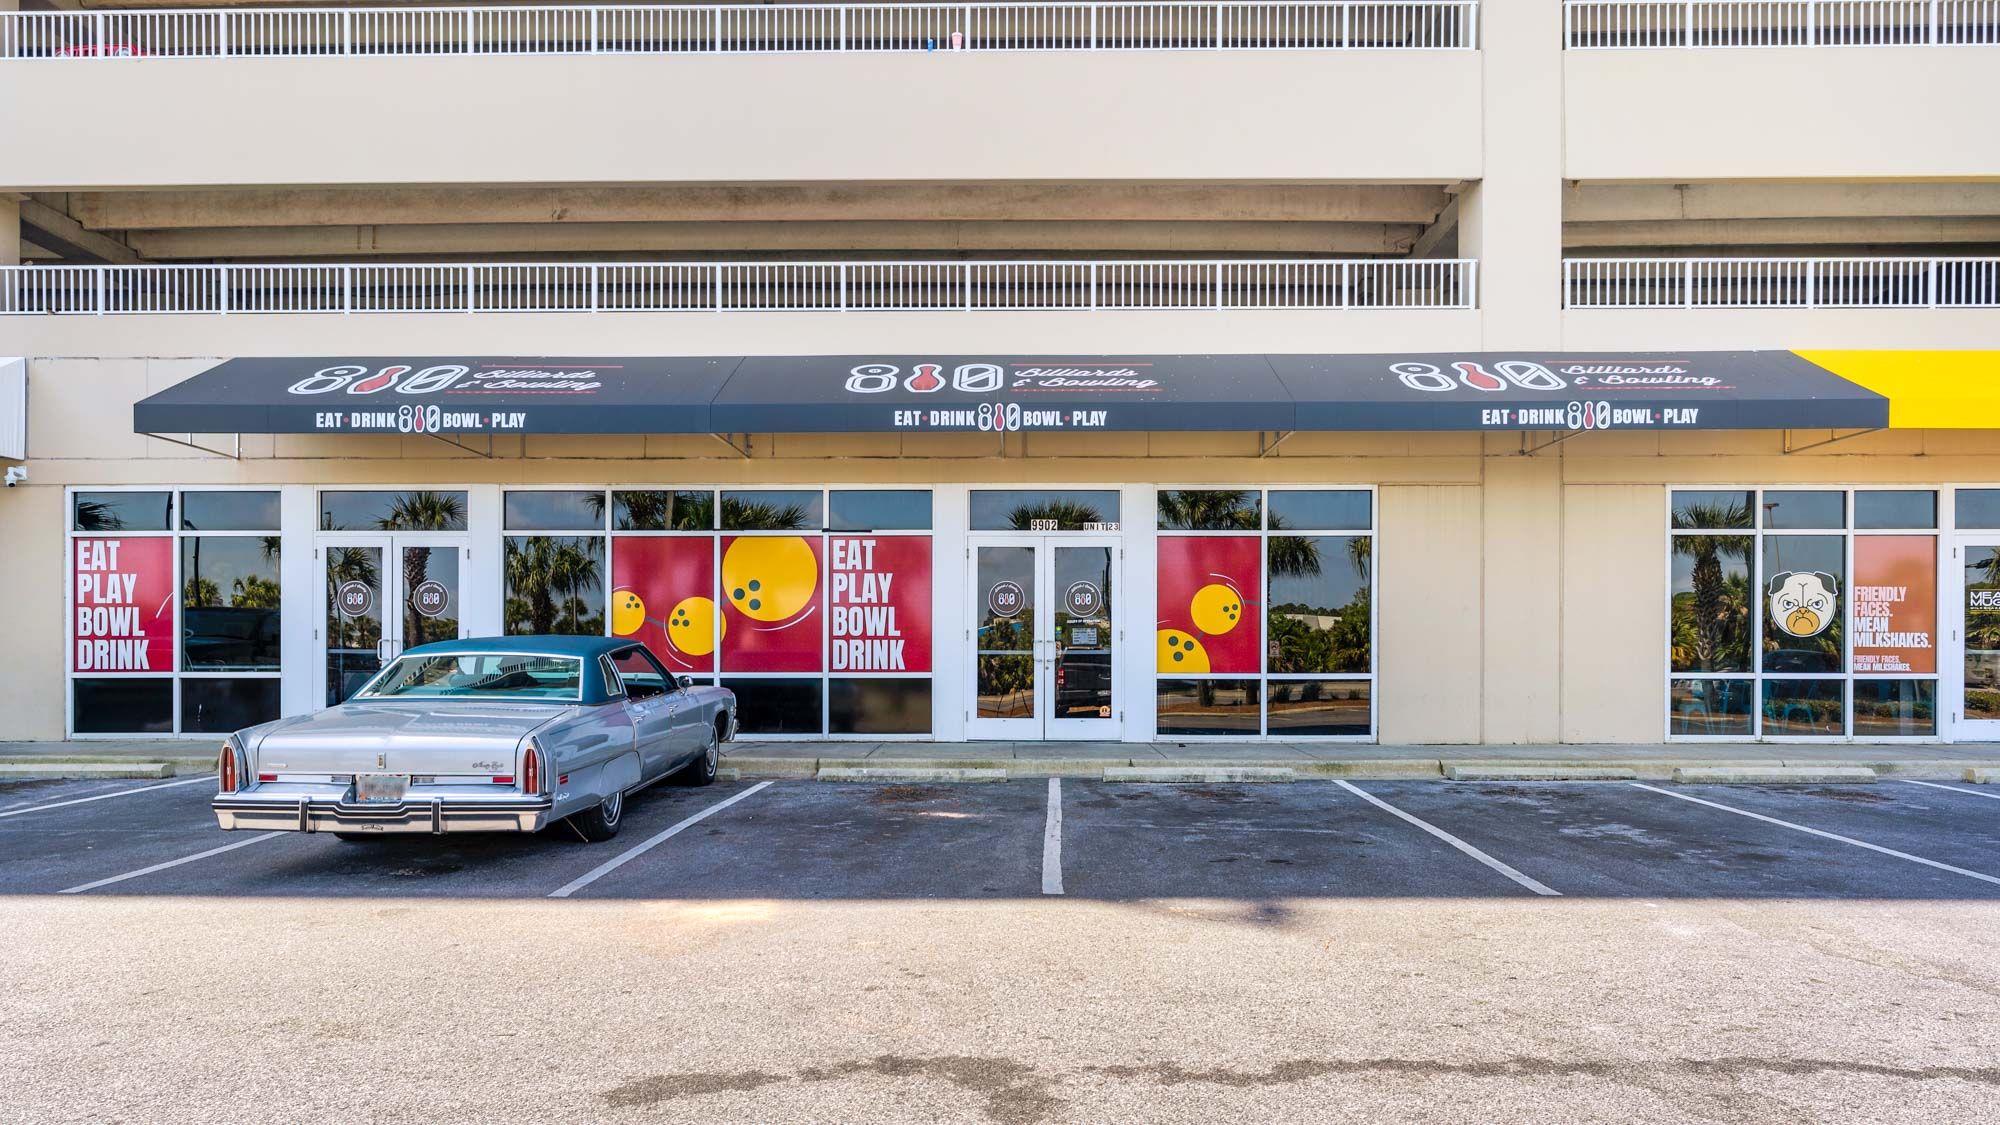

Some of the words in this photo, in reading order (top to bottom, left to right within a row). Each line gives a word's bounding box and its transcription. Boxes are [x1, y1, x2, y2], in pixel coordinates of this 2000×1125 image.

[473, 369, 596, 379] Billiards
[1014, 367, 1139, 378] Billiards
[1560, 365, 1687, 375] Billiards
[483, 378, 602, 391] Bowling
[1039, 377, 1158, 389] Bowling
[1598, 374, 1722, 386] Bowling
[1032, 520, 1057, 531] 9902
[1084, 523, 1106, 531] UNIT
[1108, 523, 1119, 531] 23
[78, 540, 120, 571] EAT
[832, 539, 876, 570] EAT
[78, 573, 137, 604] PLAY
[832, 573, 893, 603] PLAY
[1854, 586, 1907, 602] FRIENDLY
[1854, 601, 1894, 617] FACES.
[78, 606, 145, 636] BOWL
[832, 606, 901, 636] BOWL
[1854, 616, 1889, 632] MEAN
[1854, 632, 1932, 648] MILKSHAKES.
[78, 639, 149, 670] DRINK
[832, 639, 905, 670] DRINK
[1853, 655, 1880, 663] FRIENDLY
[1853, 663, 1871, 671] MEAN
